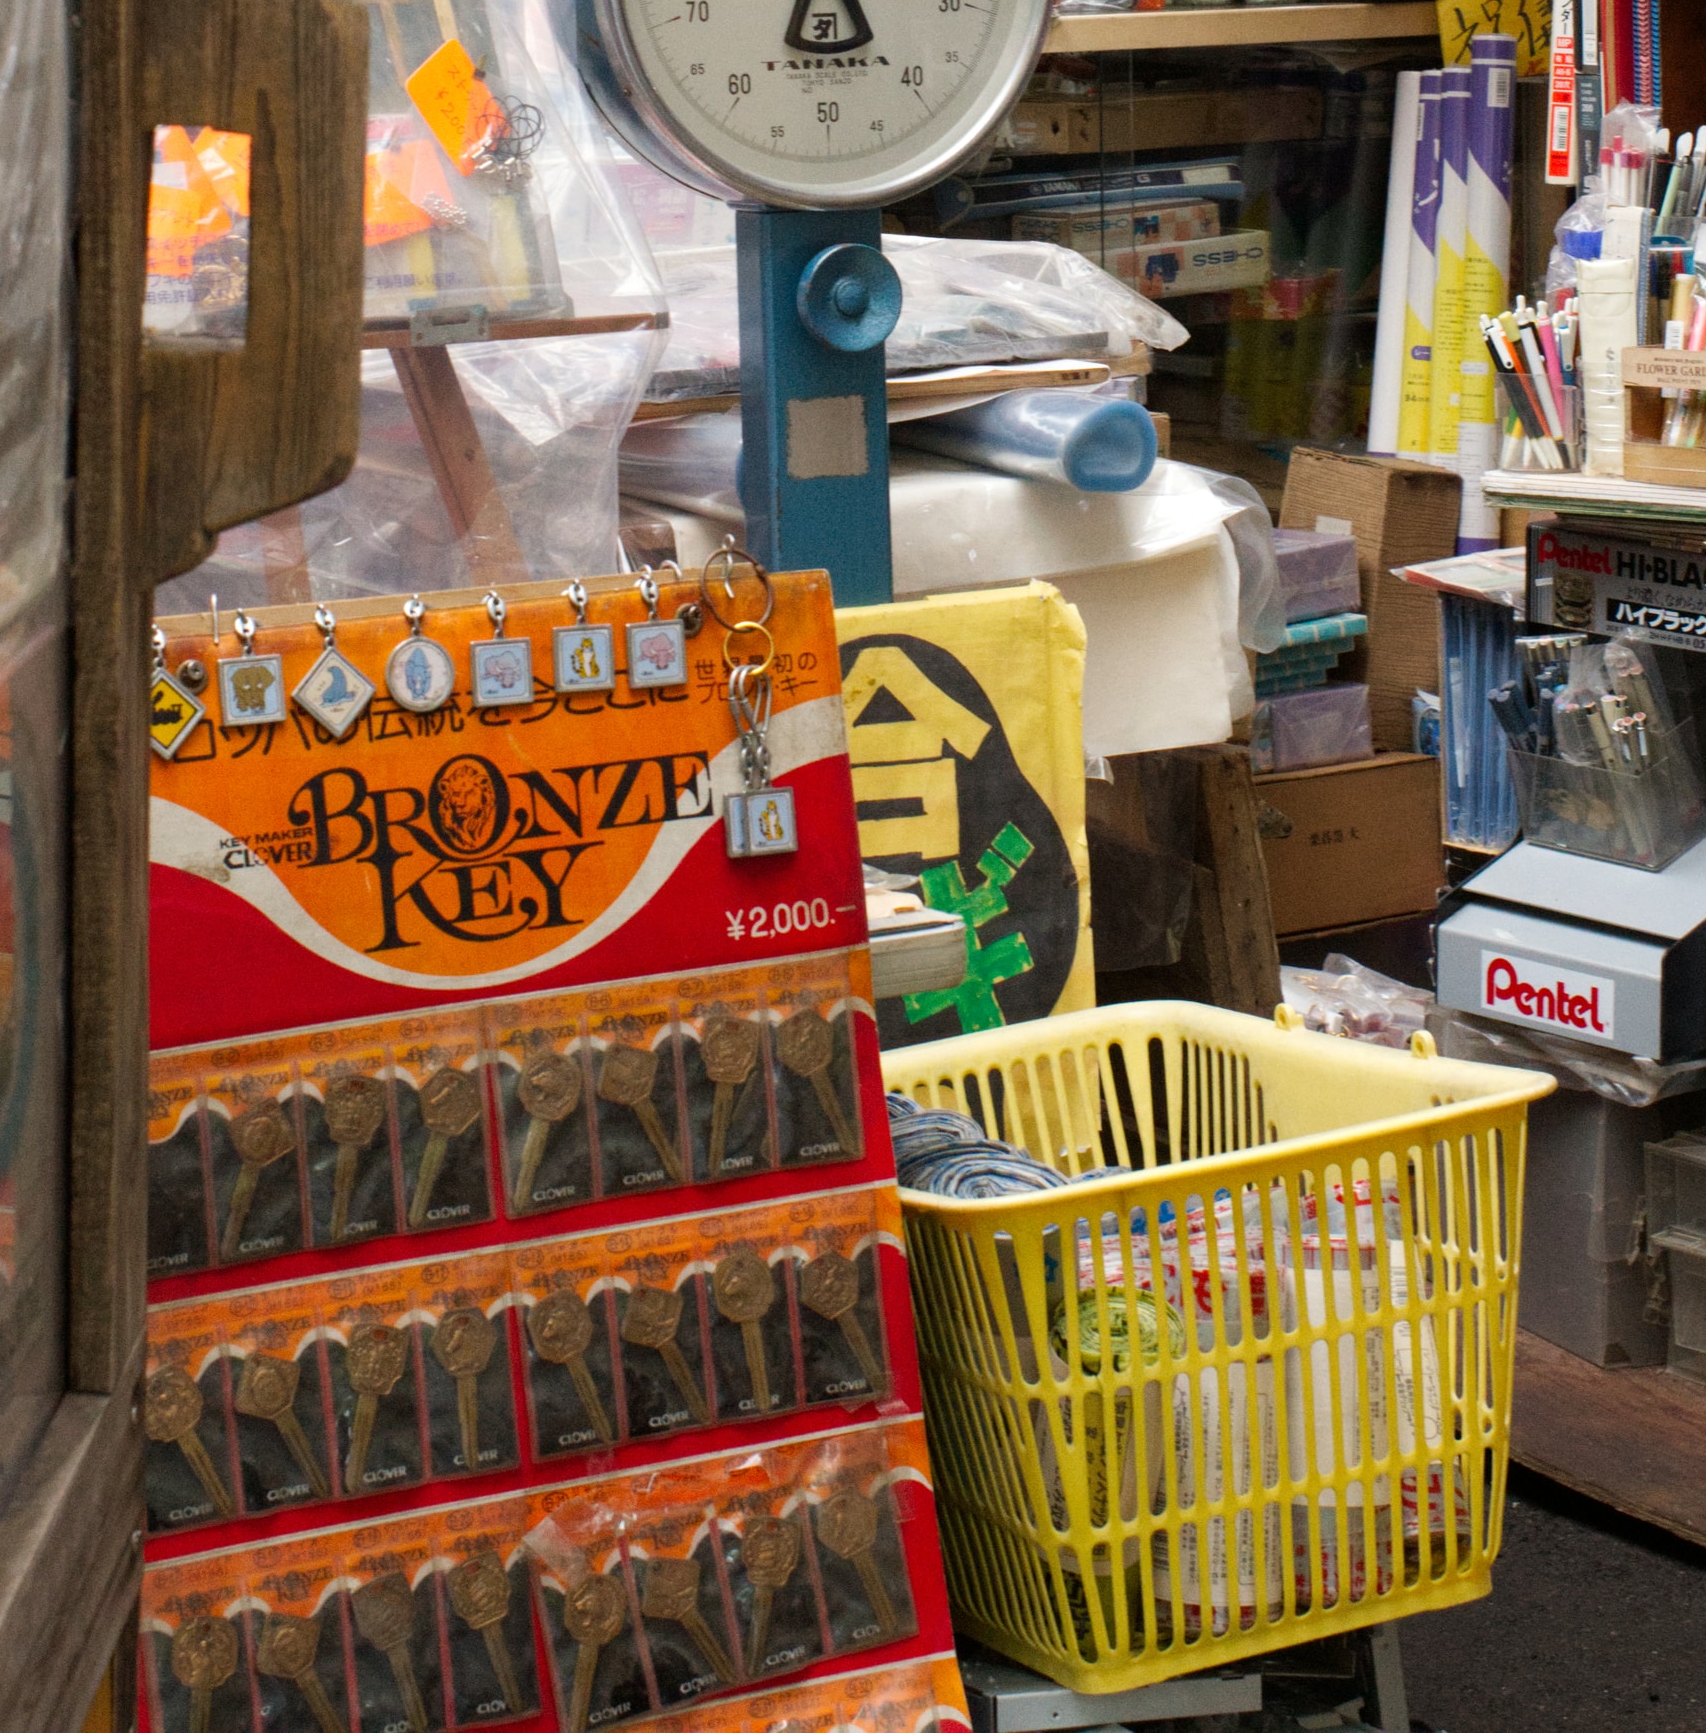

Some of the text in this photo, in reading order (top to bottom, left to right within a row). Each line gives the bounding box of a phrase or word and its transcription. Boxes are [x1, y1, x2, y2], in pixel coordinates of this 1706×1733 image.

[685, 1, 710, 23] 70
[690, 62, 706, 75] 65
[760, 56, 891, 71] TANAKA
[945, 51, 960, 64] 35
[727, 73, 752, 95] 60
[900, 65, 924, 87] 40
[816, 101, 840, 124] 50
[770, 124, 786, 138] 55
[870, 119, 885, 133] 45
[1636, 363, 1679, 376] FLOWER
[1537, 532, 1613, 576] Pentel
[286, 749, 715, 869] BRONZE
[220, 825, 315, 852] KEY MAKER
[222, 841, 315, 869] CLOVER
[355, 840, 605, 955] KEY
[1485, 957, 1605, 1033] Pentel
[239, 1234, 285, 1254] CLOVER
[648, 1410, 690, 1430] CLOVER
[362, 1464, 408, 1484] CLOVER
[588, 1701, 632, 1723] CLOVER
